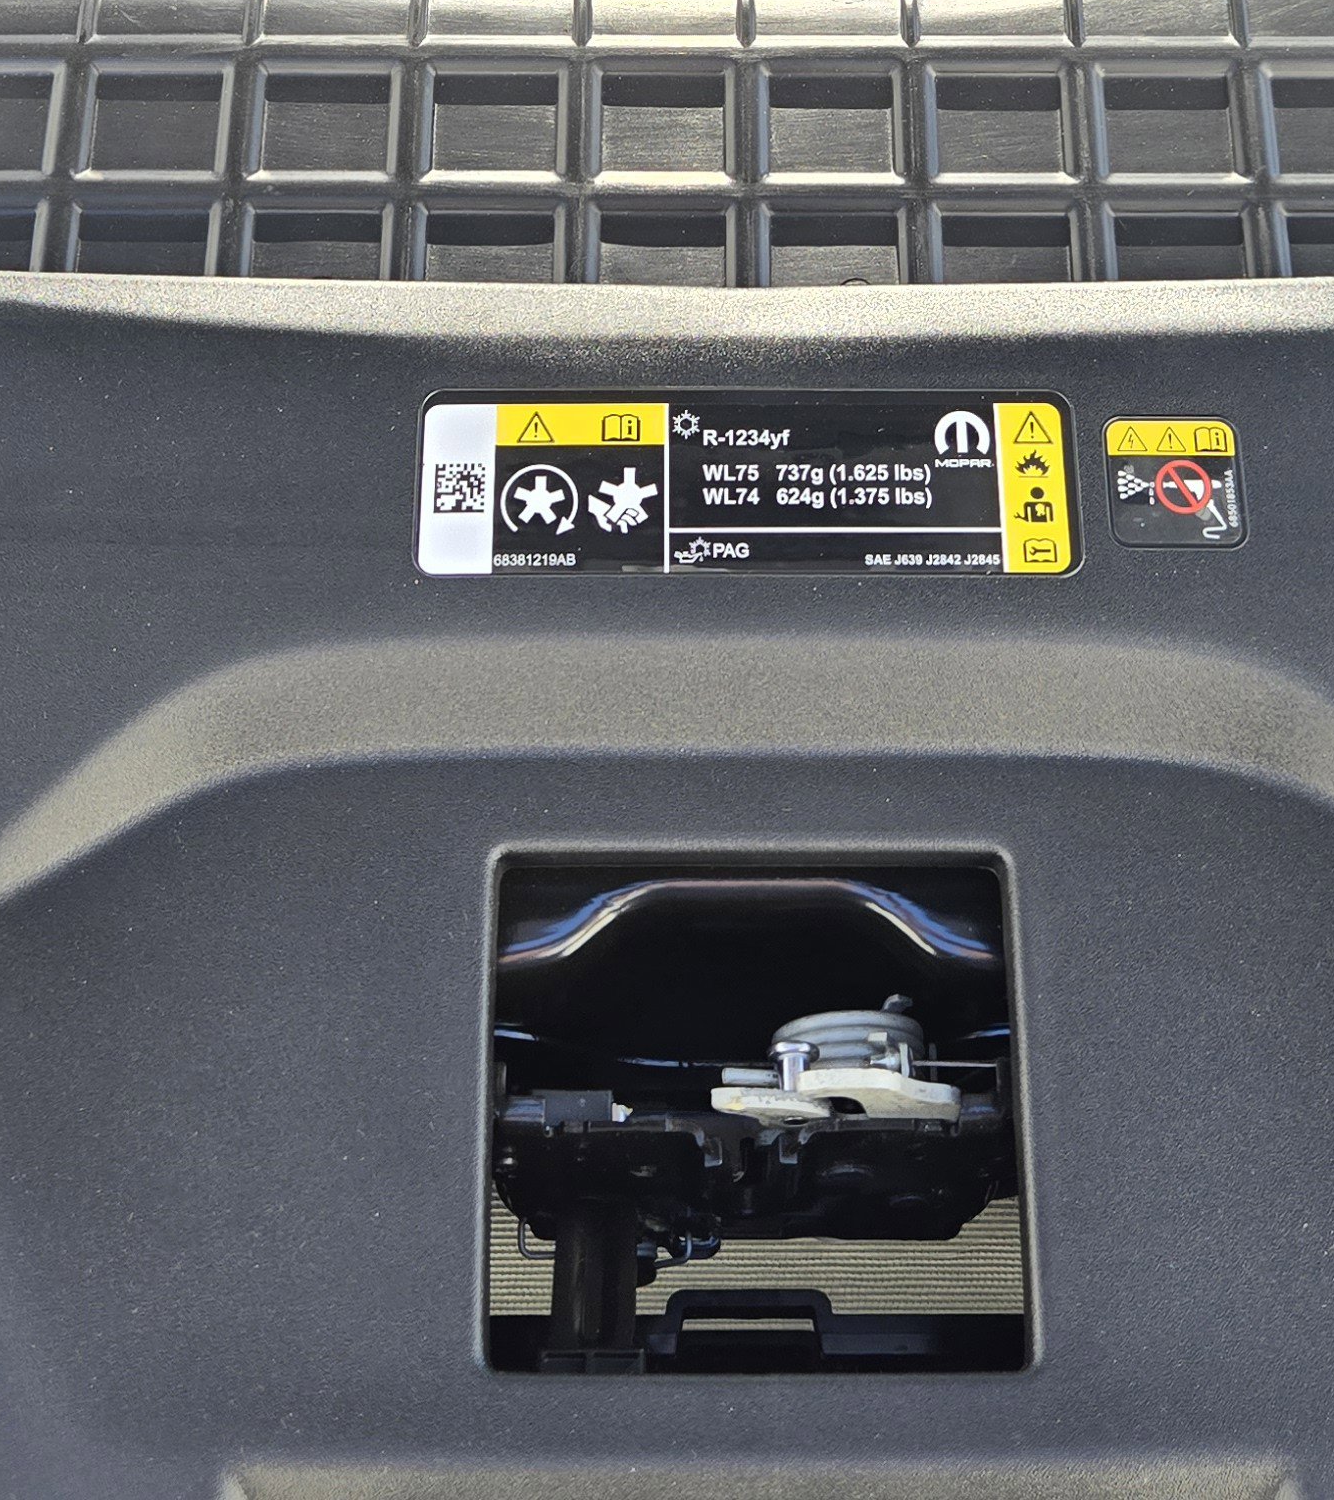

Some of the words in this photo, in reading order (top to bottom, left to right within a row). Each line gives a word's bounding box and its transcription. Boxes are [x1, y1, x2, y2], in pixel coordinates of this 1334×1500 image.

[703, 429, 790, 449] R-1234yf
[935, 458, 992, 468] MOPAR
[703, 464, 759, 481] WL75
[776, 464, 824, 485] 737g
[829, 464, 889, 485] (1.625
[894, 464, 931, 485] lbs)
[703, 488, 760, 505] WL74
[776, 488, 824, 509] 624g
[830, 488, 890, 509] (1.375
[895, 488, 932, 509] lbs)
[712, 543, 750, 559] PAG
[493, 553, 577, 567] 68381219AB
[865, 554, 892, 566] SAE
[894, 554, 923, 566] J639
[926, 554, 962, 566] J2842
[964, 554, 1000, 566] J2845
